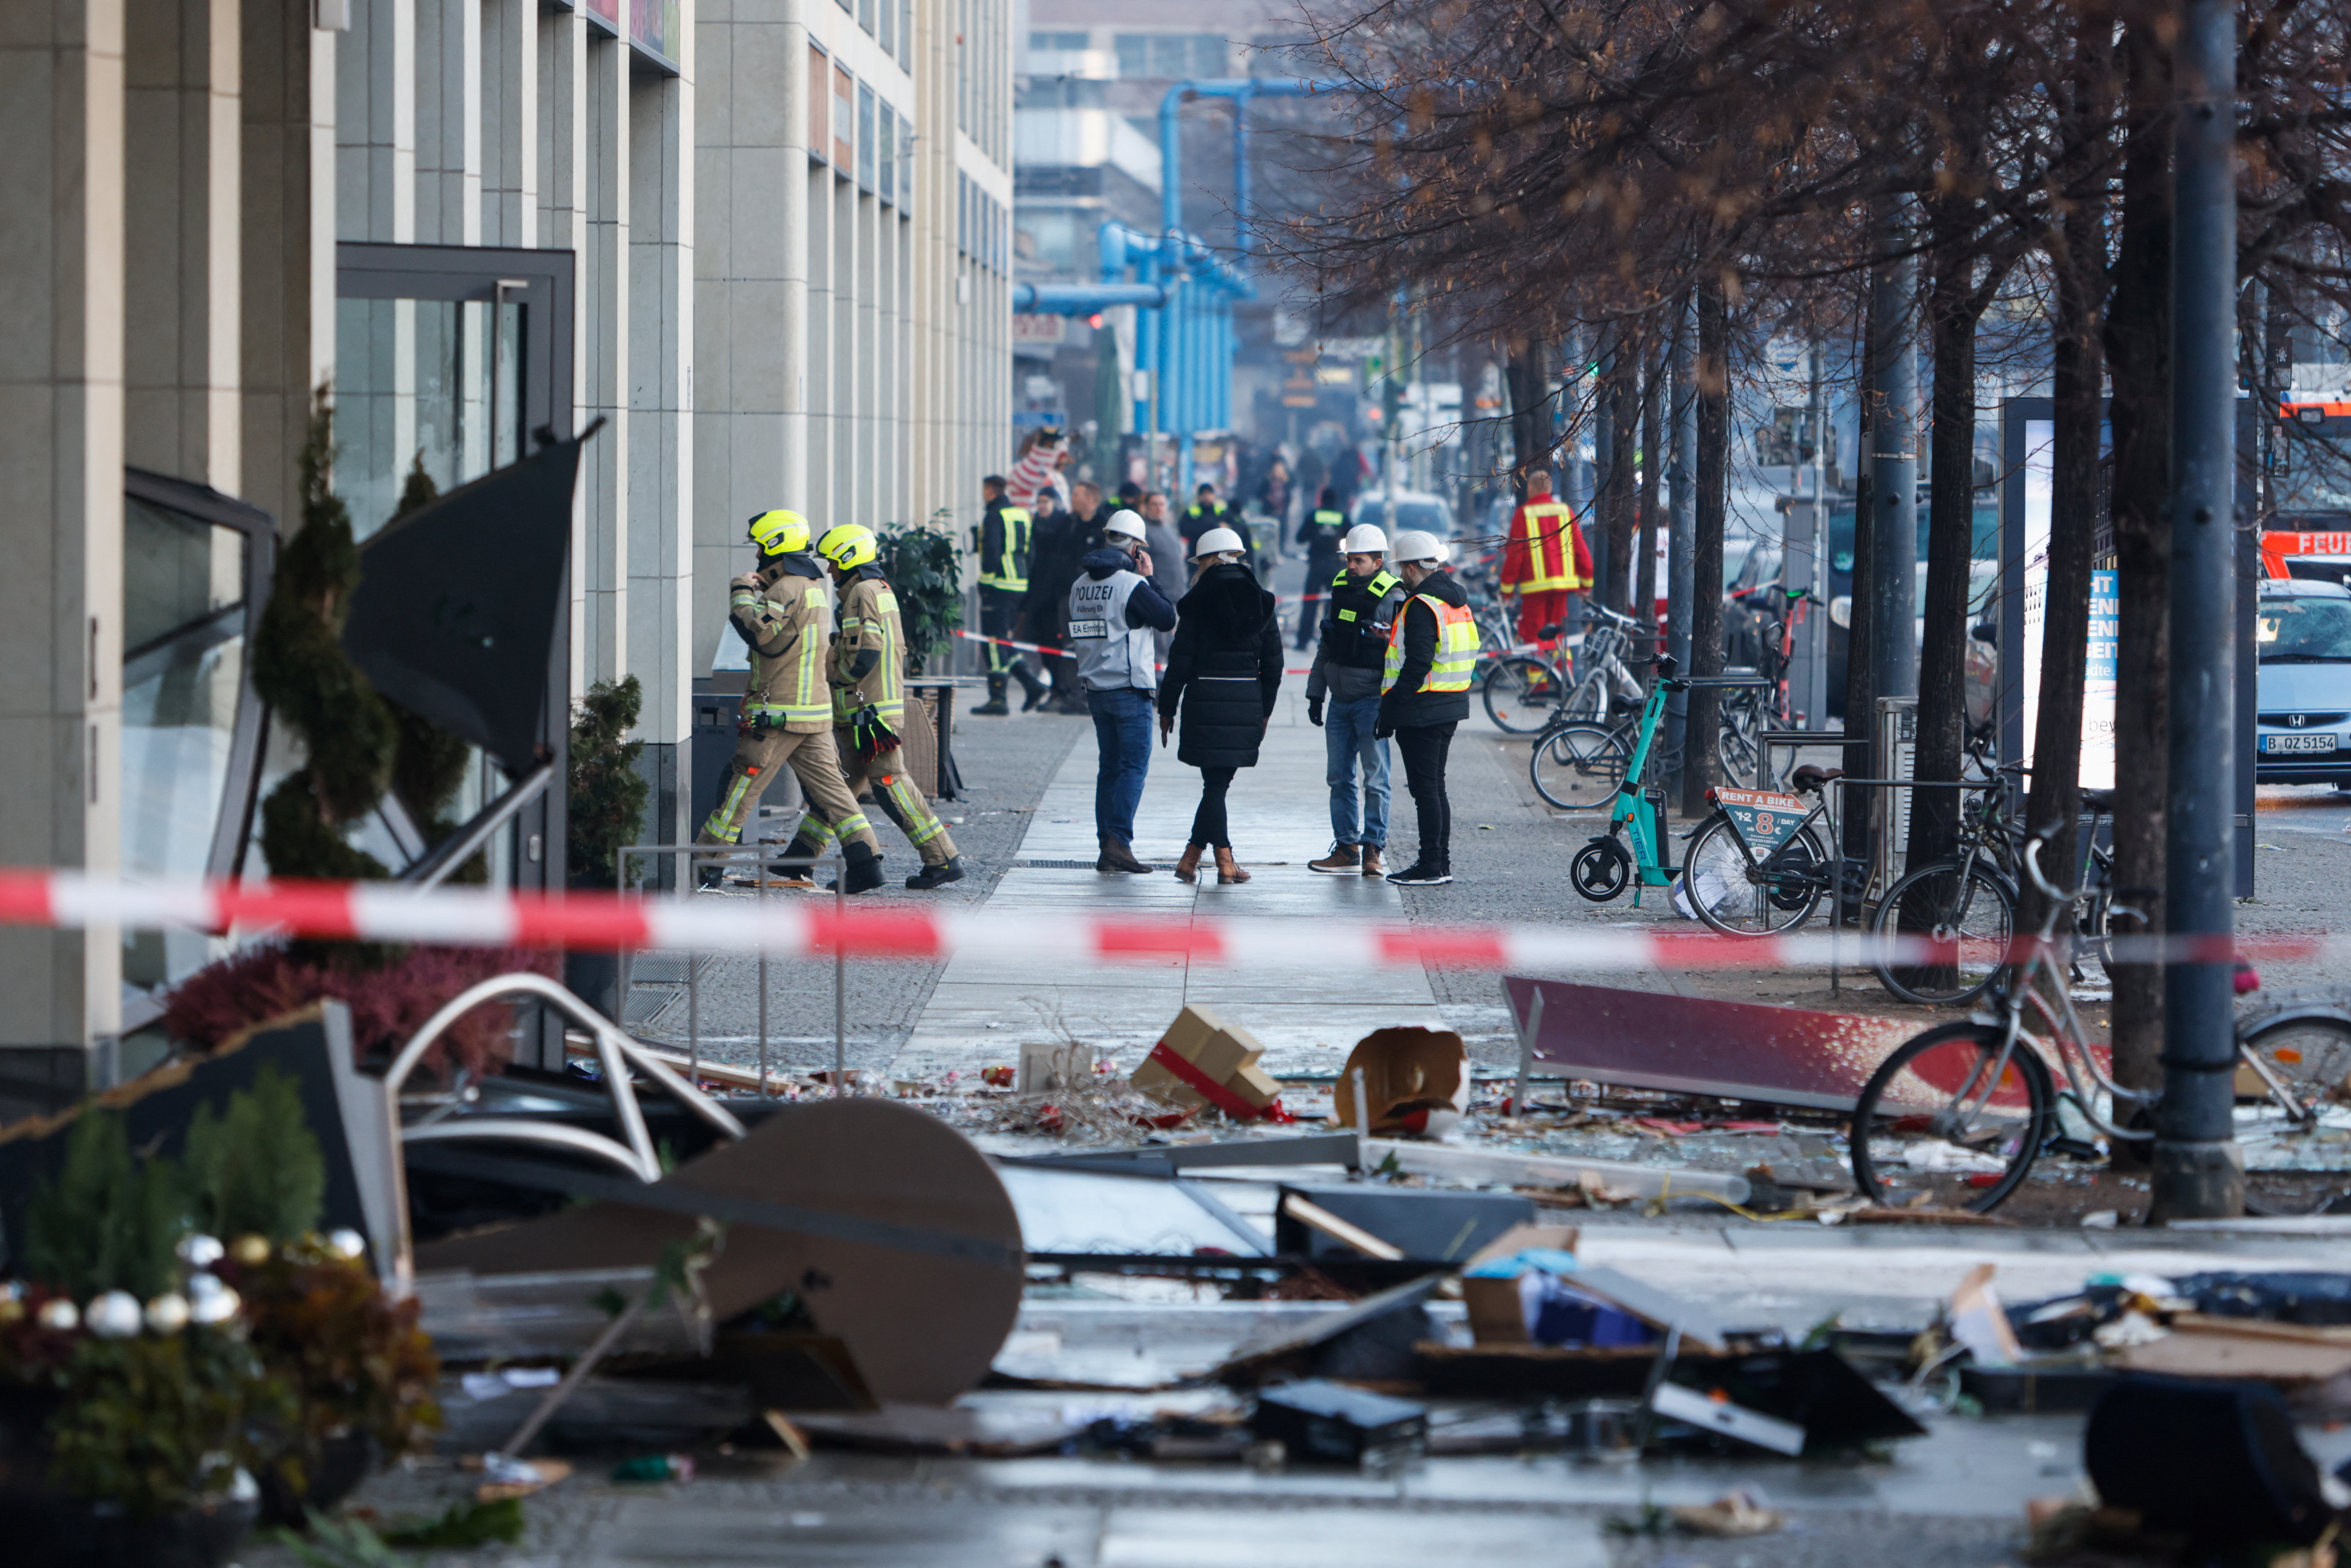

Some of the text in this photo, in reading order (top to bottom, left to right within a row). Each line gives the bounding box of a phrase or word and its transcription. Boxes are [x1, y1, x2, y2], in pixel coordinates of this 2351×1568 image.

[1075, 586, 1113, 601] POLIZEI
[1073, 625, 1082, 633] EA
[2269, 737, 2334, 750] B QZ 5154
[1722, 792, 1795, 807] RENT A BIKE
[1756, 813, 1774, 834] 8
[1632, 827, 1646, 861] TIER
